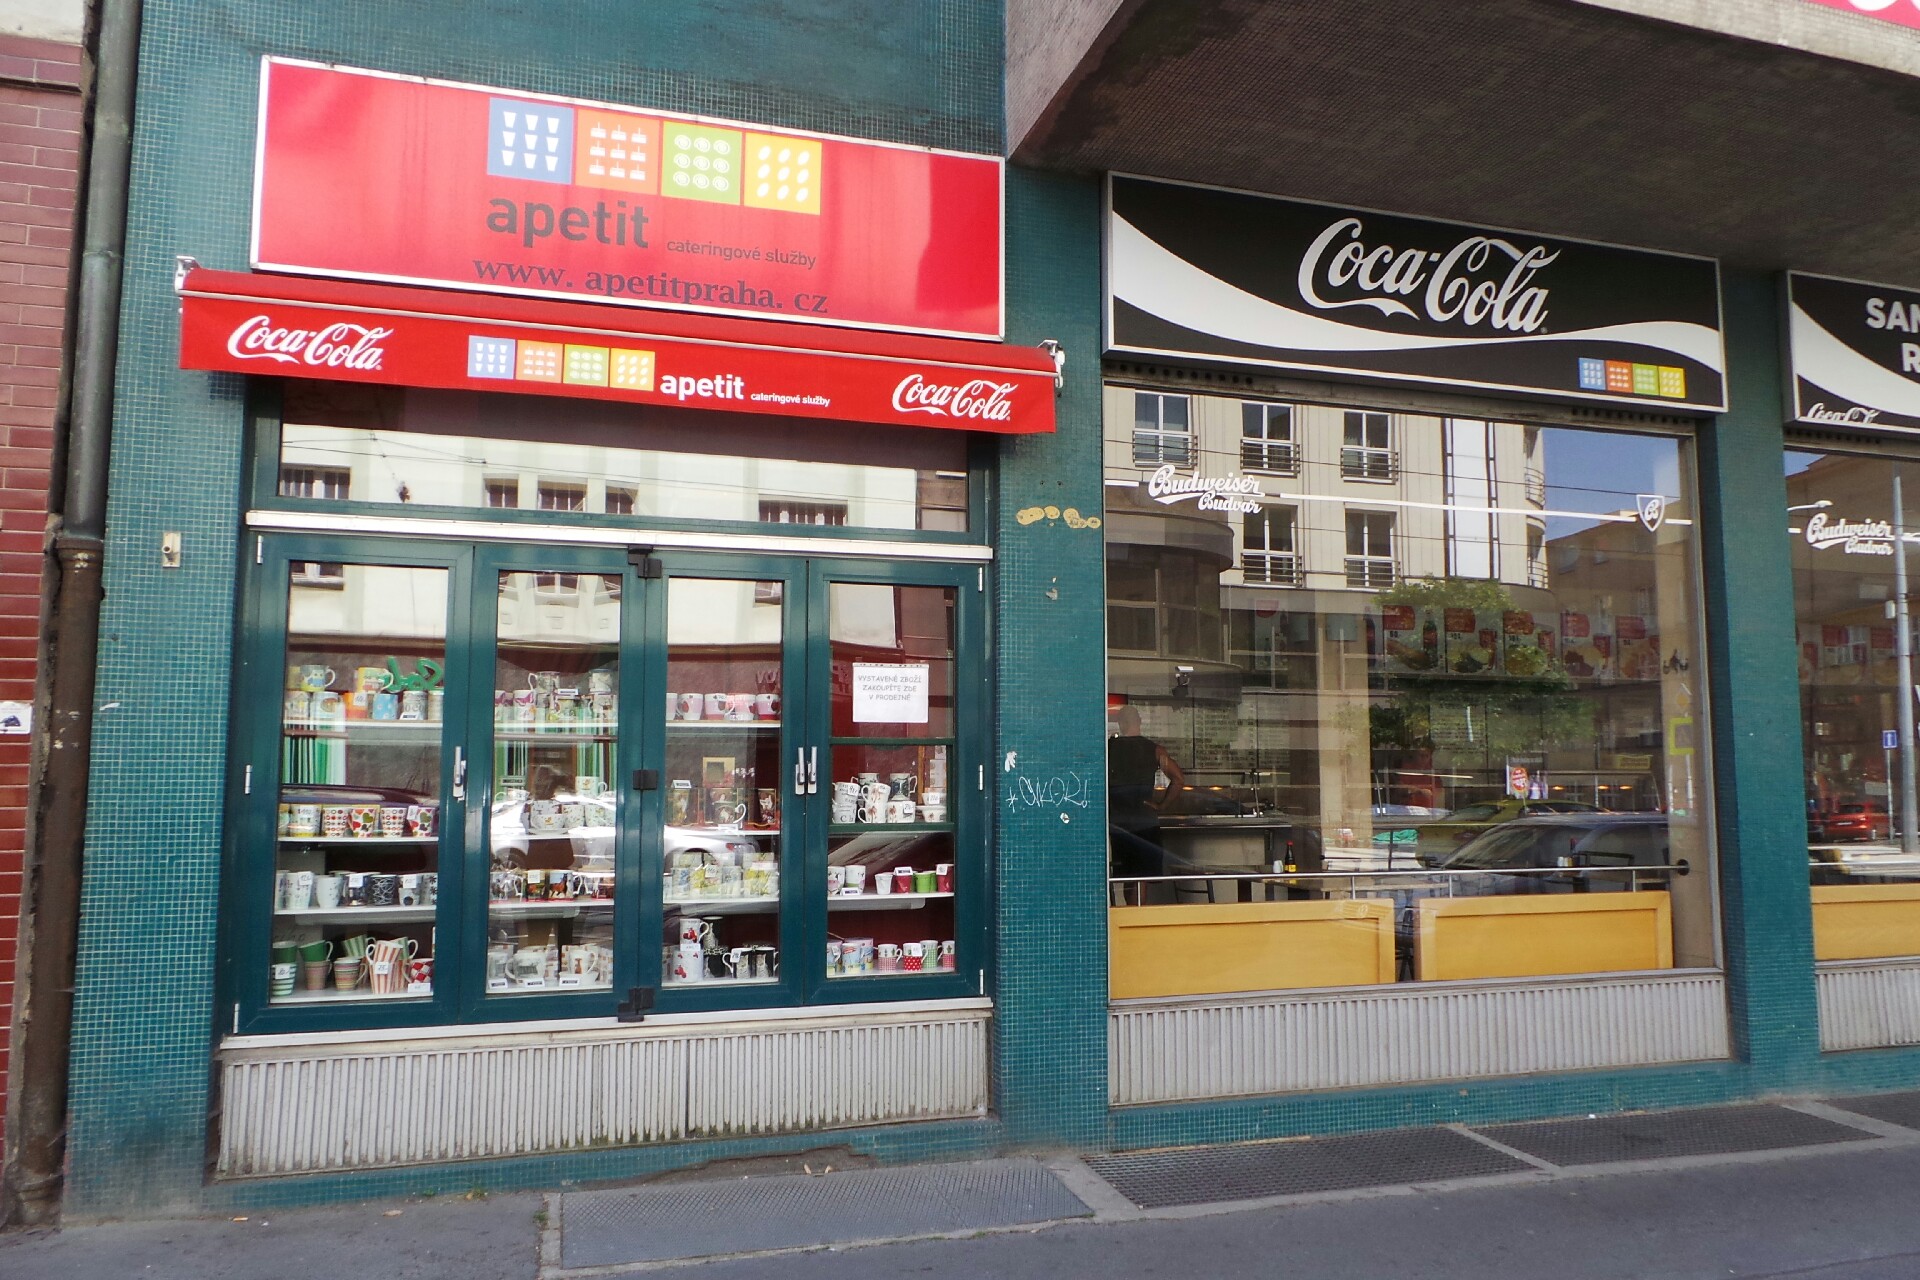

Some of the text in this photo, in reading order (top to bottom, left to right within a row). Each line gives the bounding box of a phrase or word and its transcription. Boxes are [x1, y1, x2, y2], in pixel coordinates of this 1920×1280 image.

[486, 196, 649, 249] apetit
[666, 238, 816, 269] cateringové služby
[1298, 217, 1561, 334] Coca-Cola
[794, 292, 828, 313] cz
[227, 315, 393, 371] Coca-Cola
[660, 371, 744, 401] apetit
[750, 390, 831, 408] cateringové služby
[891, 373, 1018, 421] Coca-Cola
[1148, 464, 1263, 500] Budweiser
[1198, 490, 1263, 513] Budvar
[1806, 512, 1895, 546] Budweiser
[1844, 535, 1894, 555] Budvar
